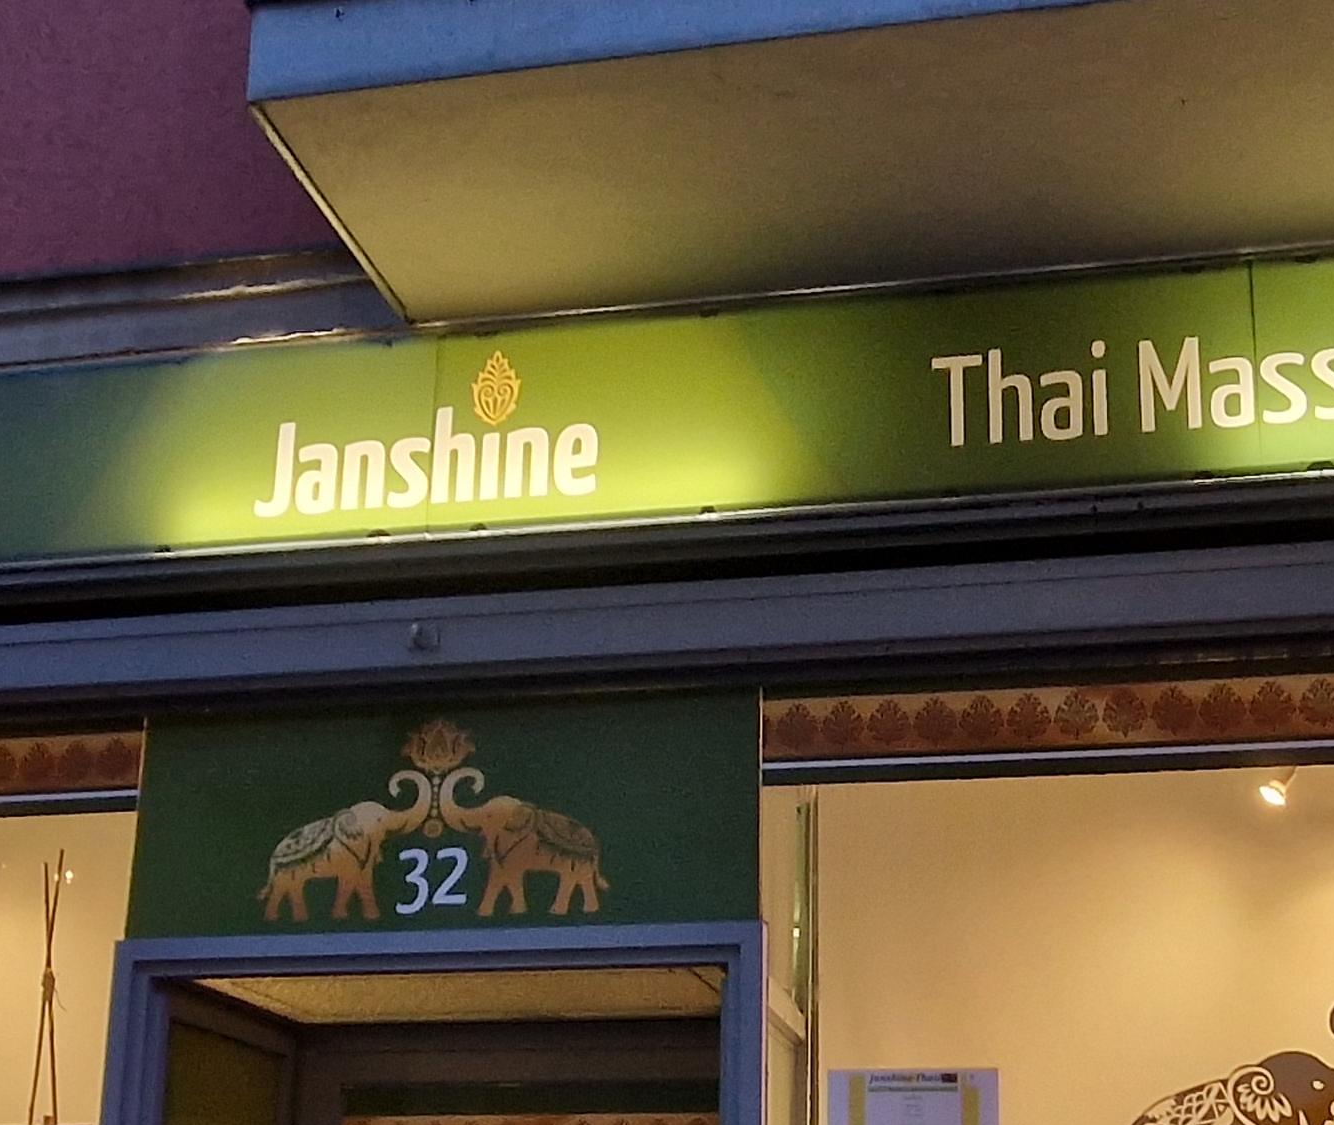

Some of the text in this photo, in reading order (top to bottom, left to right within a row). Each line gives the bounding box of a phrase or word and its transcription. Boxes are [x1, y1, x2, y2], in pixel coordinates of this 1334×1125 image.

[931, 339, 1108, 447] Thai
[254, 406, 599, 518] Janshine
[395, 847, 467, 915] 32
